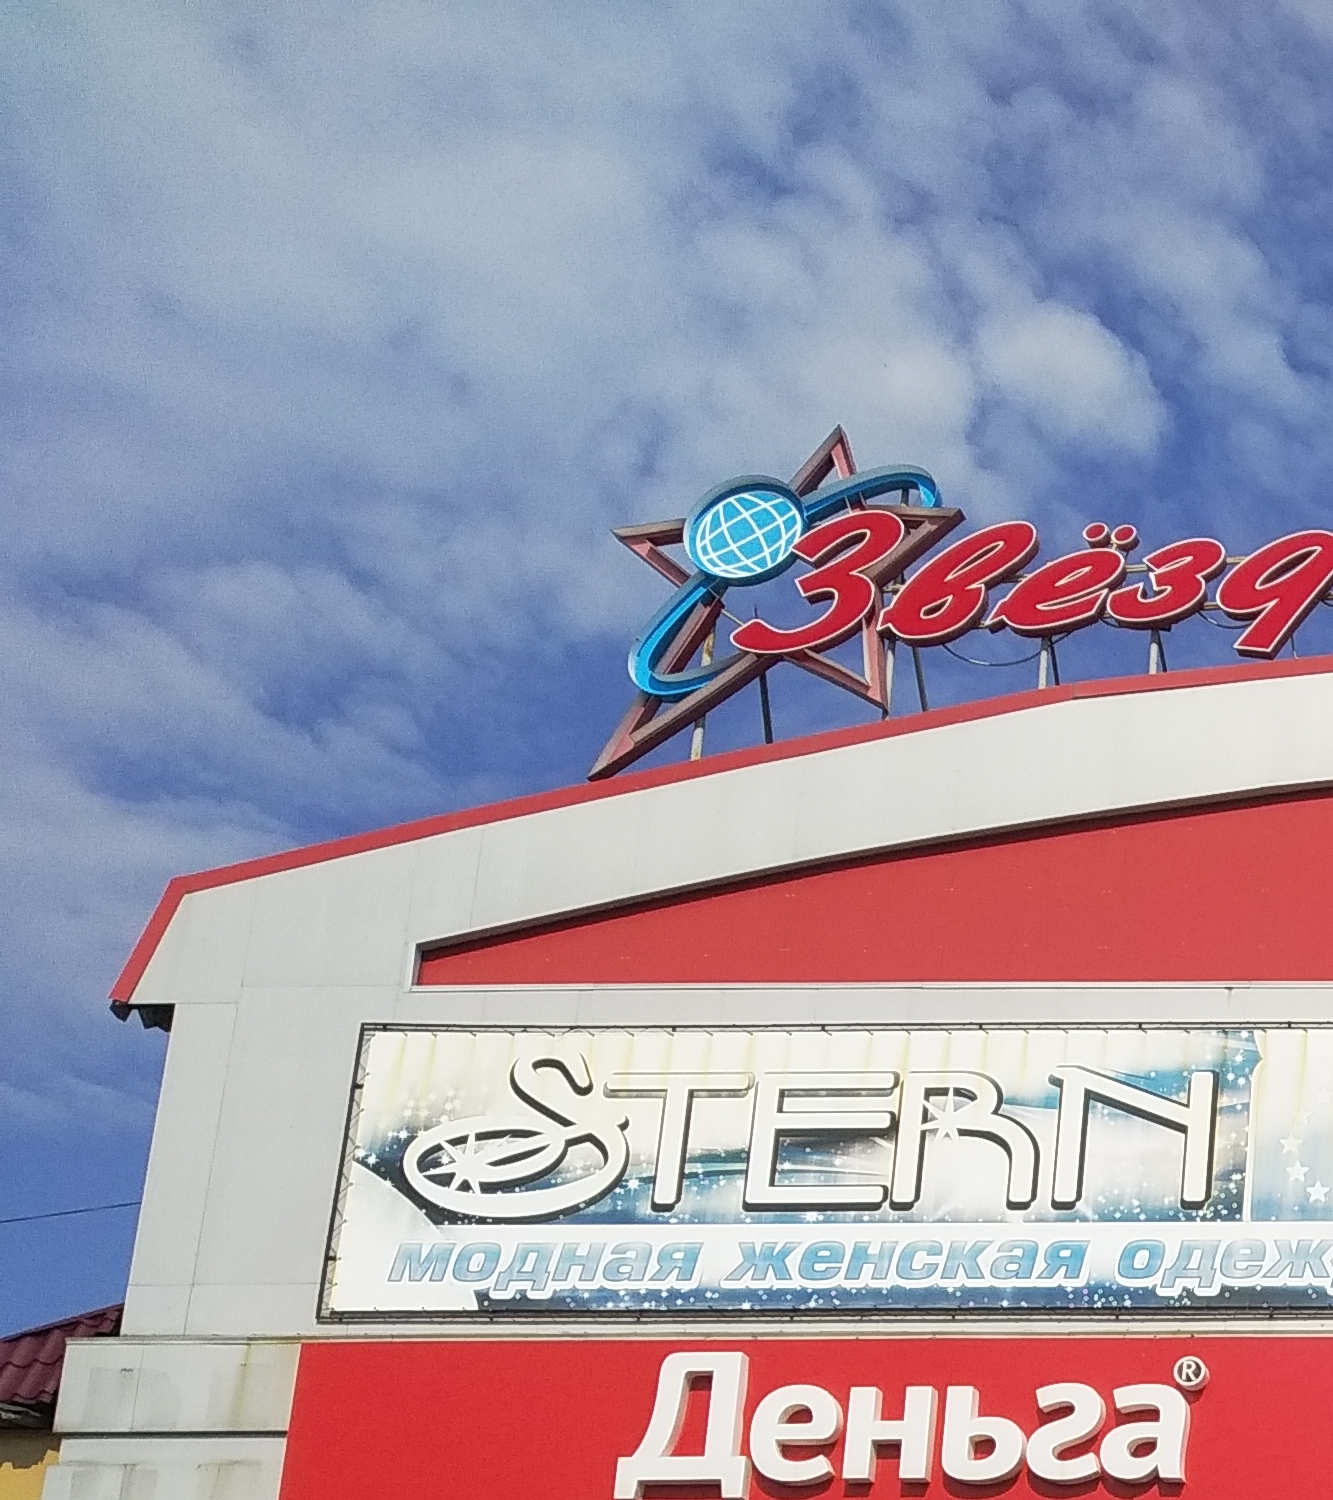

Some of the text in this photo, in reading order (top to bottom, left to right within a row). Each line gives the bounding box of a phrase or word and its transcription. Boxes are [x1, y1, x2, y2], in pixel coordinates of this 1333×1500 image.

[402, 1052, 1216, 1219] STERN
[388, 1239, 700, 1297] модная
[724, 1234, 1087, 1290] женская
